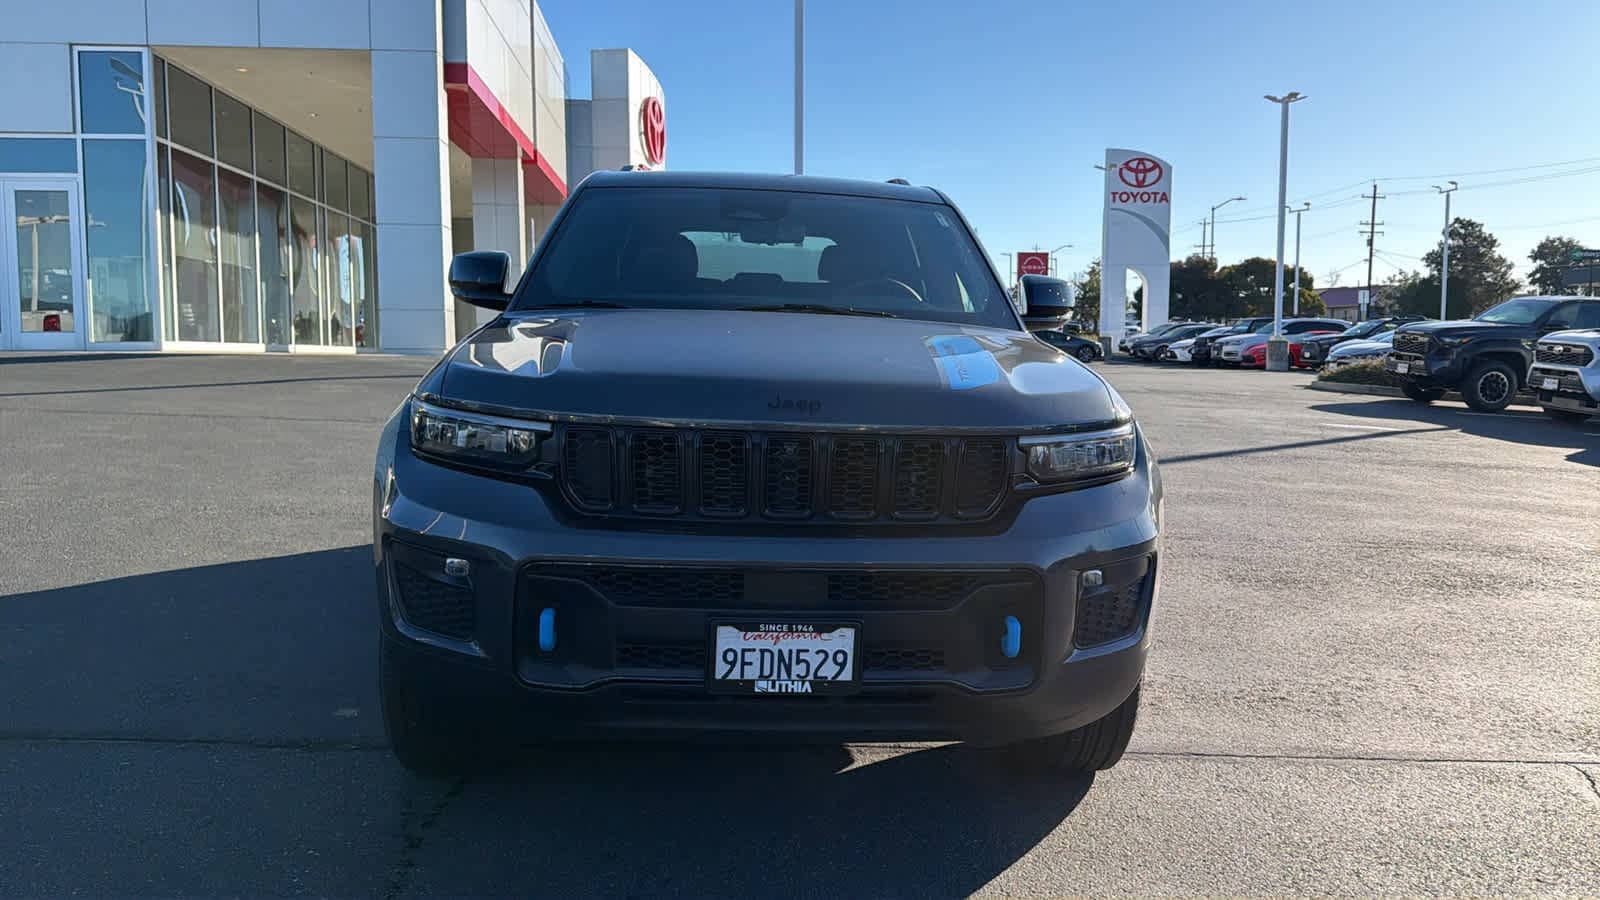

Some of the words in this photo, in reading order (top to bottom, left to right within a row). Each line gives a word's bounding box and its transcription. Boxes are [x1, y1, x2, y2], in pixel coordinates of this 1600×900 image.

[1111, 191, 1169, 204] TOYOTA
[768, 392, 822, 416] Jeep
[759, 624, 789, 632] SINCE
[792, 624, 814, 632] 1946
[721, 648, 848, 680] 9FDN529
[767, 681, 812, 693] LITHIA
